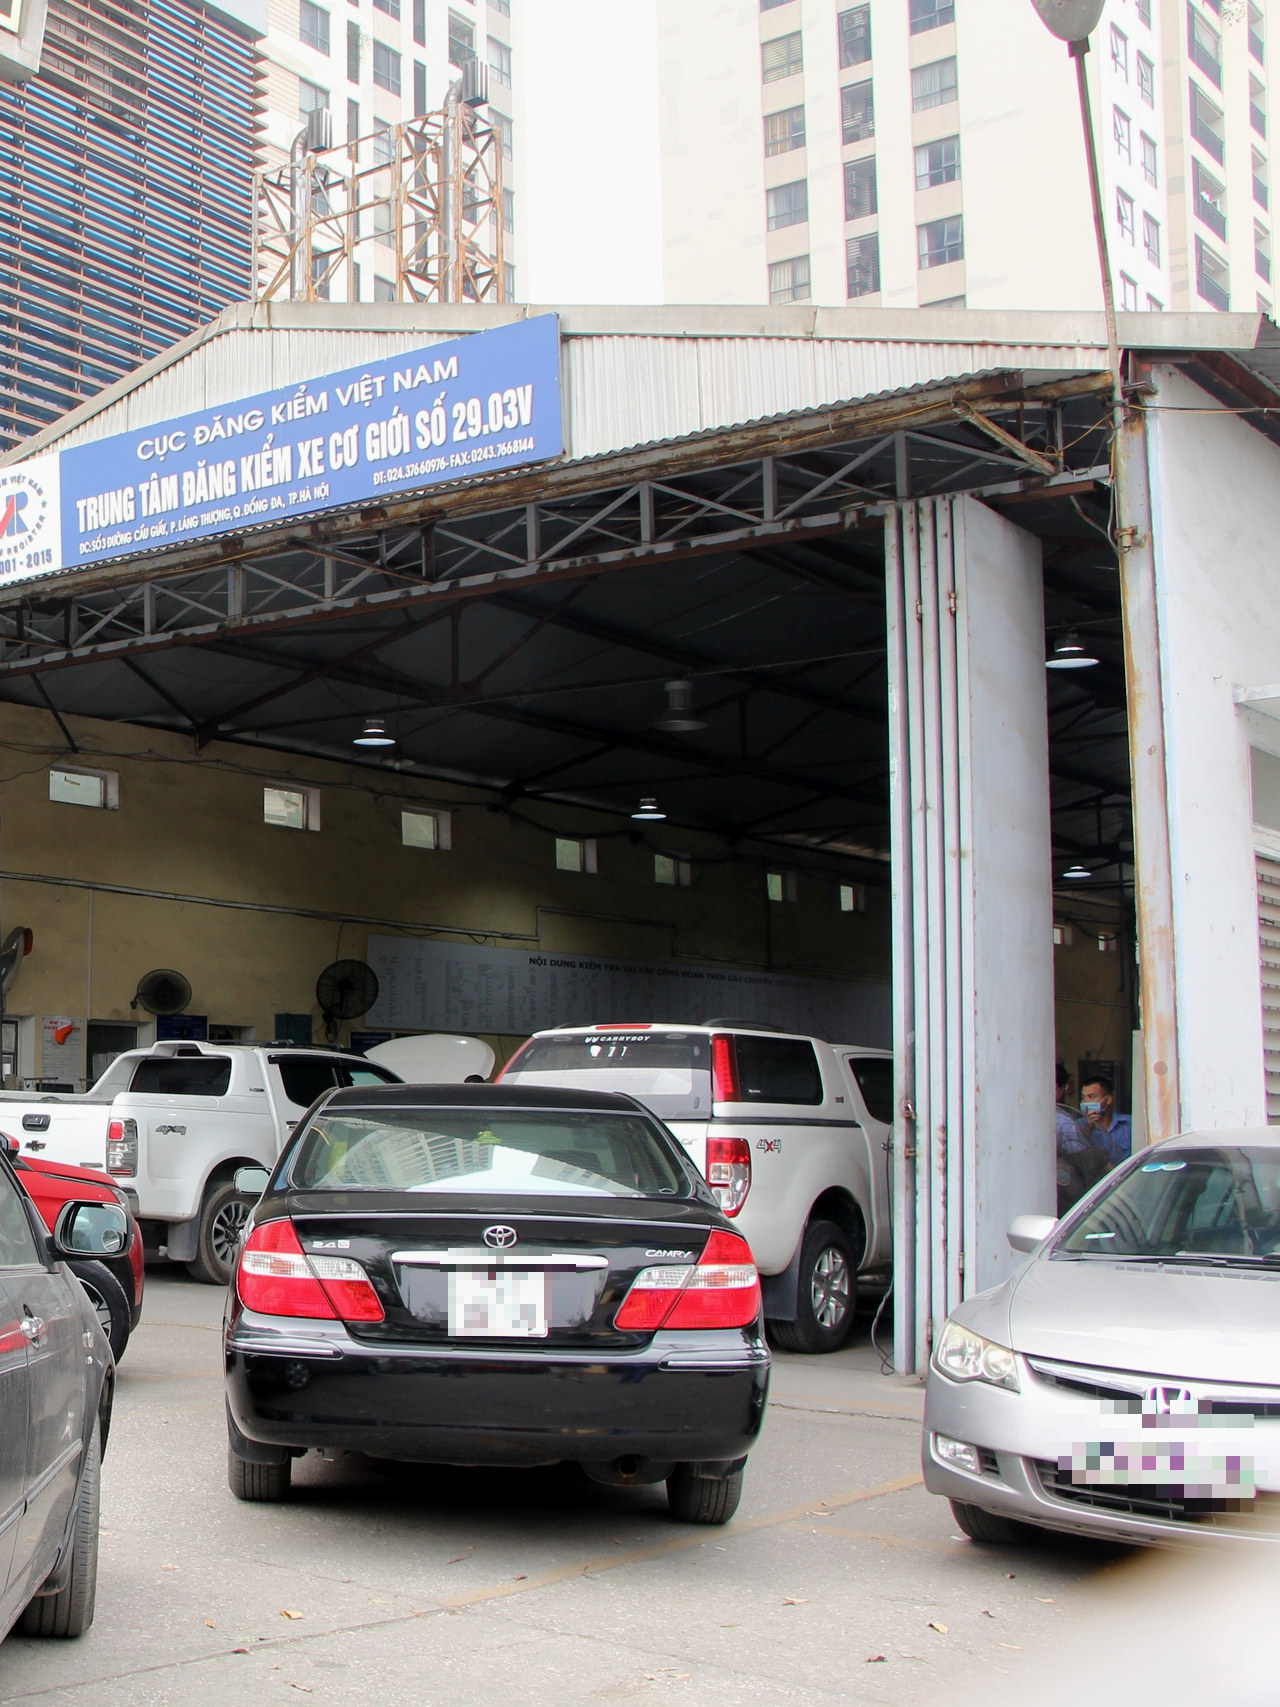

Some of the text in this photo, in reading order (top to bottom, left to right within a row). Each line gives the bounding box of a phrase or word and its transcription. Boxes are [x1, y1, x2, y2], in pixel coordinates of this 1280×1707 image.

[137, 356, 458, 462] CỤC ĐĂNG KIỂM VIỆT NAM
[76, 384, 533, 533] TRUNG TÂM ĐĂNG KIỂM XE CƠ GIỚI SỐ 29.03V
[28, 478, 44, 497] NAM
[314, 481, 330, 500] NỘI
[26, 548, 52, 569] 2015
[529, 955, 547, 967] NỘI
[550, 959, 577, 969] DUNG
[603, 964, 621, 972] TRA
[645, 1249, 693, 1259] CAMRY
